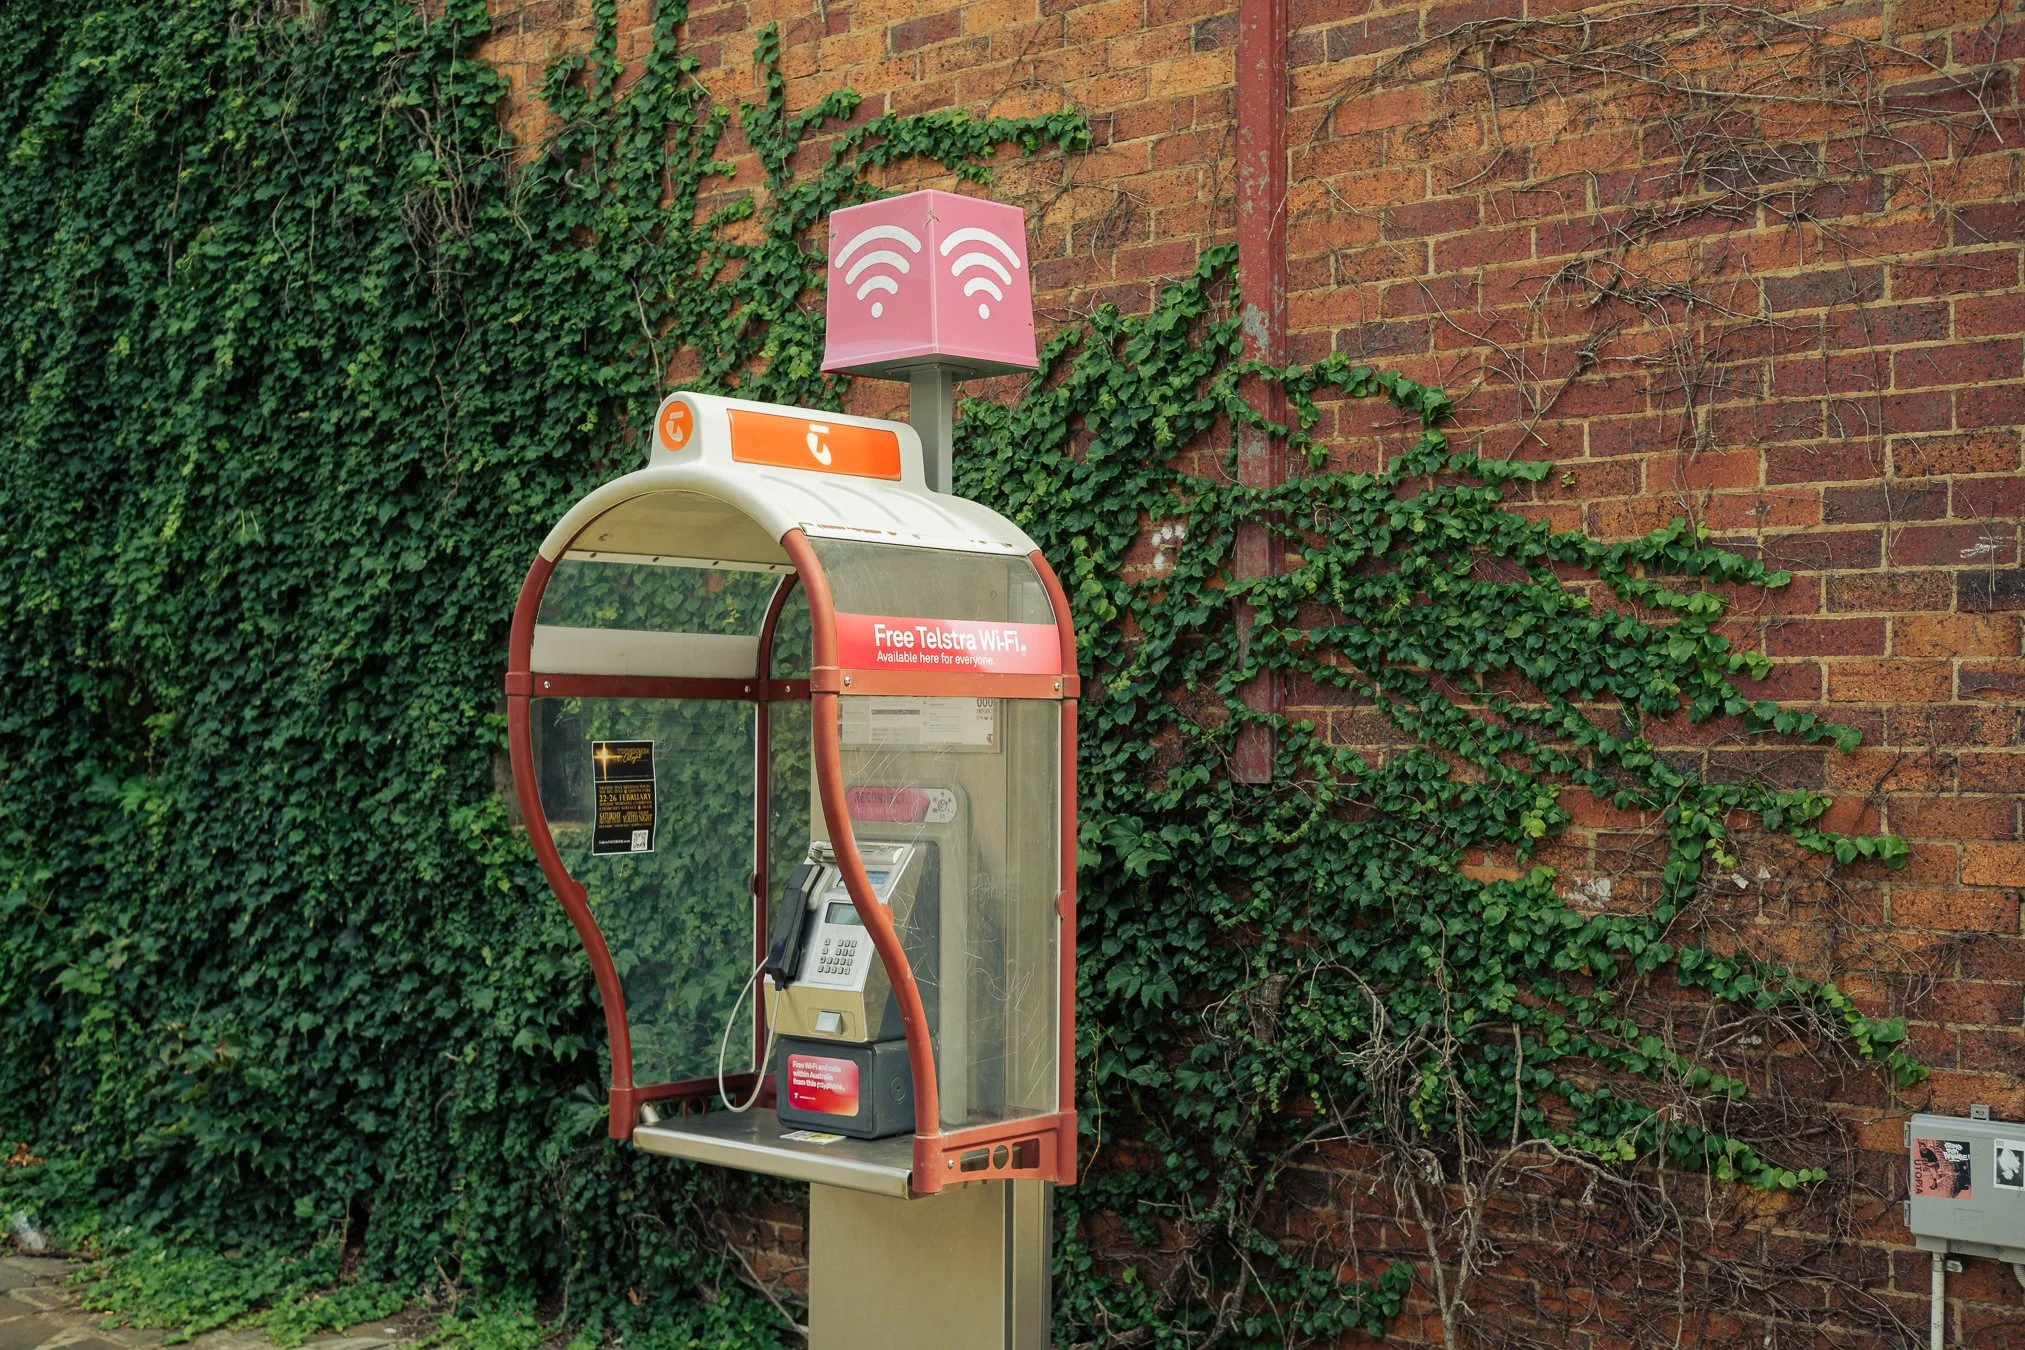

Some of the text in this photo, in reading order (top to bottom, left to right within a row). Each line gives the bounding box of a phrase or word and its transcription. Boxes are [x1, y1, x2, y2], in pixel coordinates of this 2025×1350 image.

[874, 623, 914, 648] Free
[915, 625, 977, 651] Telstra
[877, 650, 996, 668] Available here for everyone.
[599, 793, 652, 802] 22-26 FEBRUARY
[793, 1061, 804, 1069] Free
[805, 1062, 818, 1070] Wi-Fi
[793, 1070, 834, 1081] within Australia
[793, 1078, 805, 1086] from
[806, 1079, 817, 1087] this
[1914, 1160, 1923, 1194] UTOPIA
